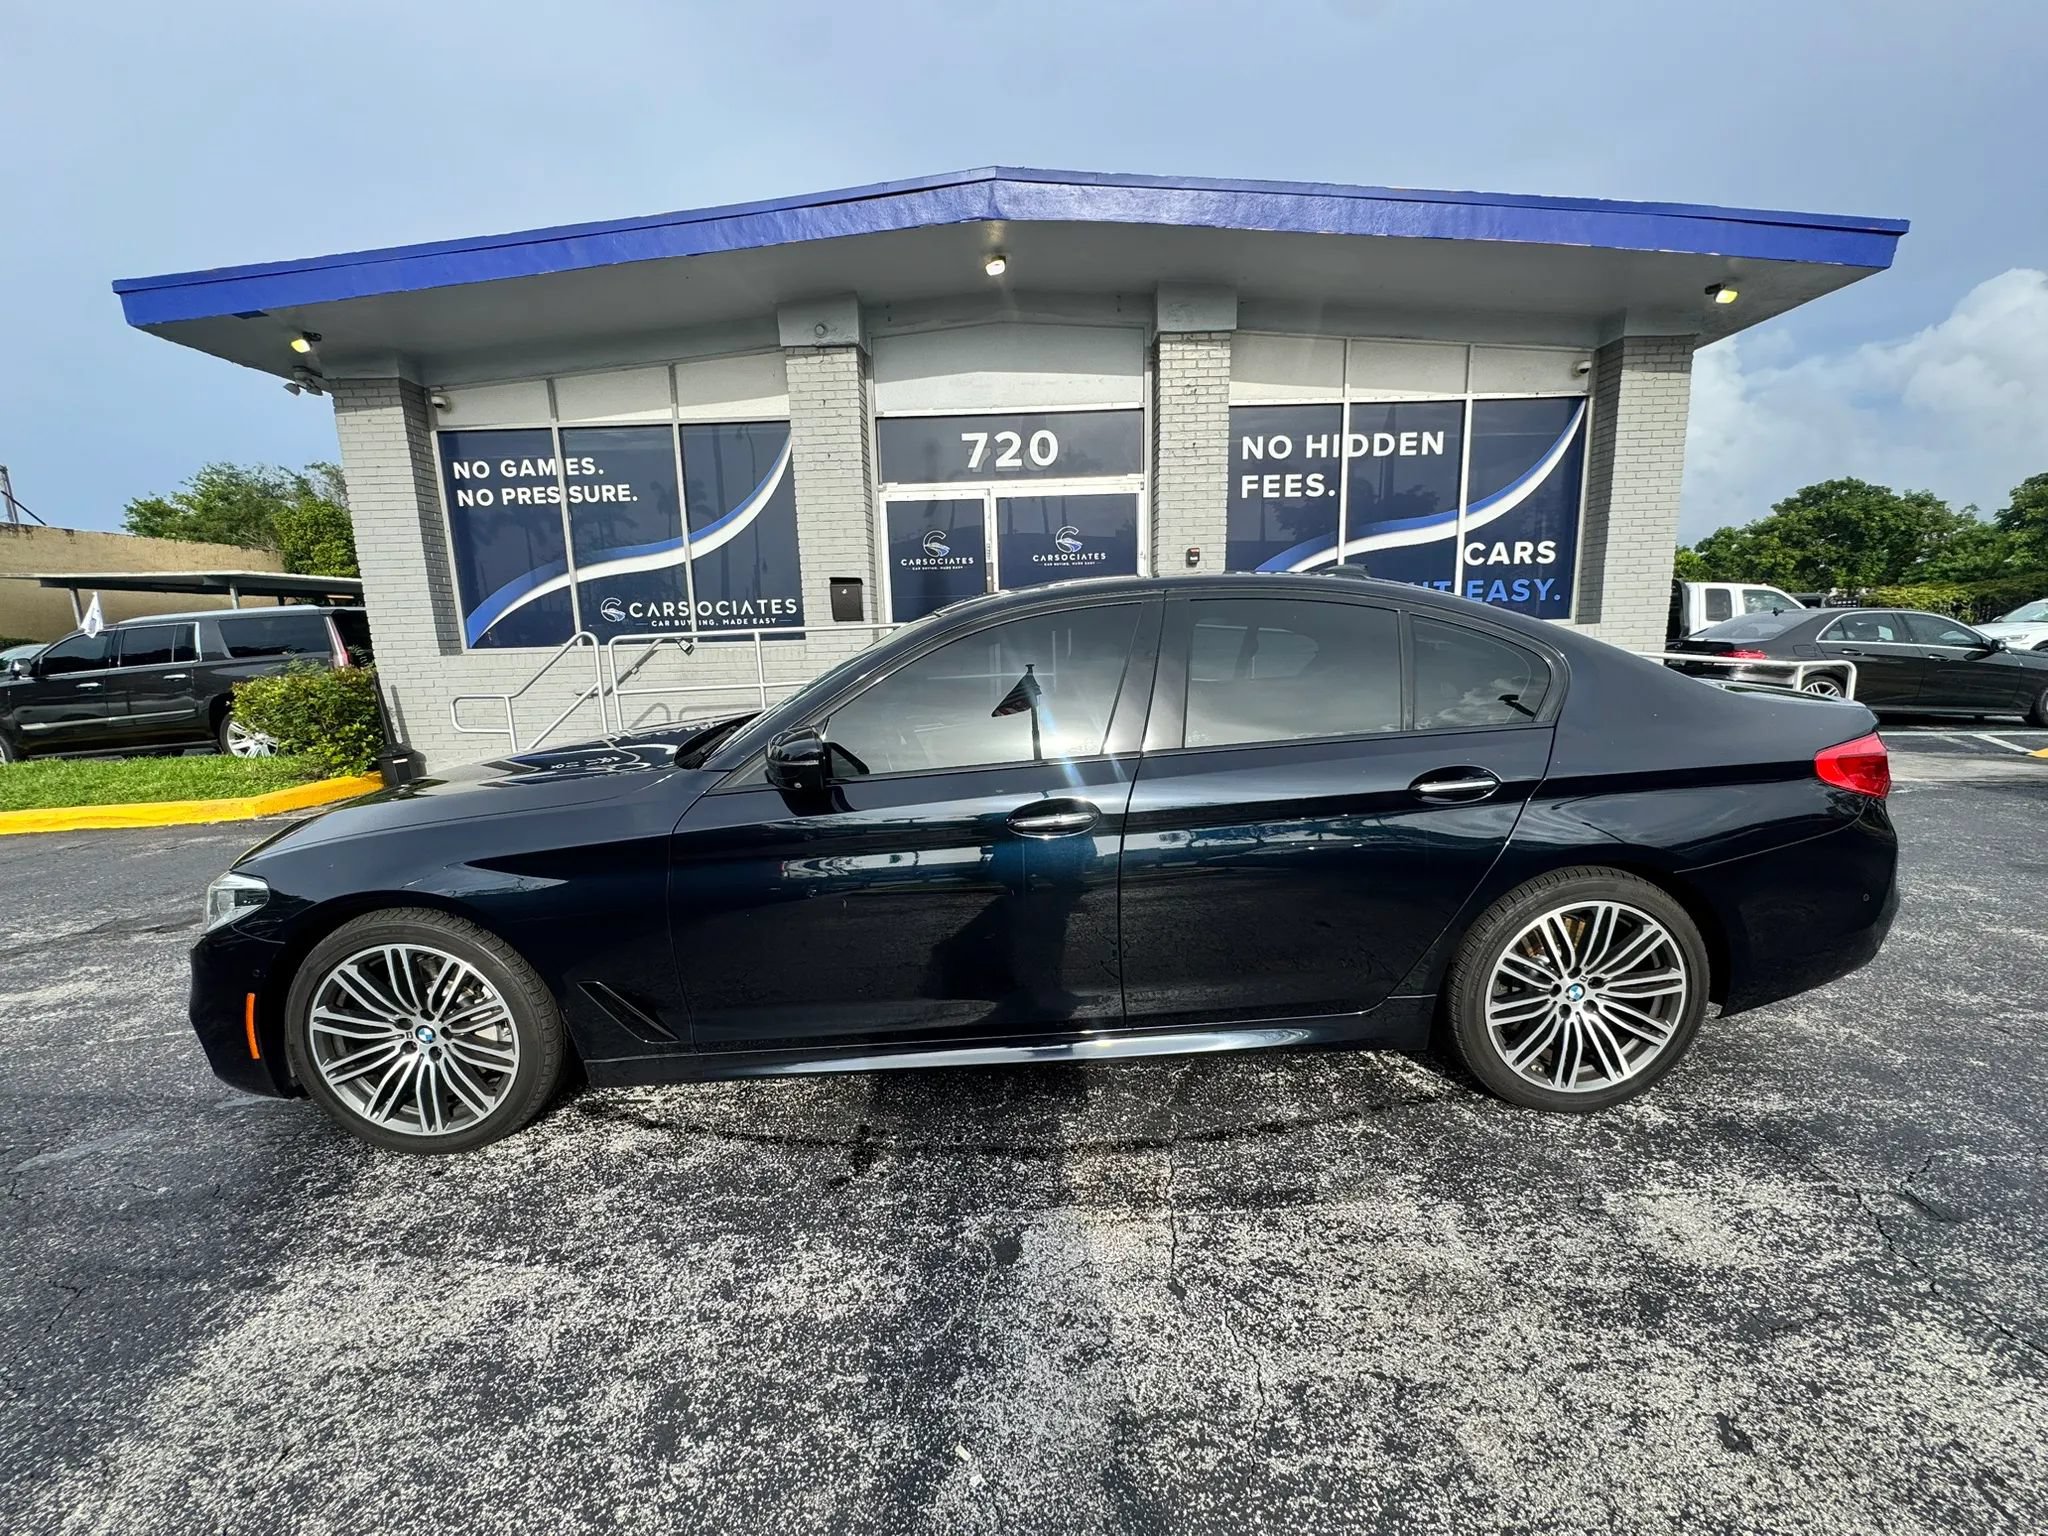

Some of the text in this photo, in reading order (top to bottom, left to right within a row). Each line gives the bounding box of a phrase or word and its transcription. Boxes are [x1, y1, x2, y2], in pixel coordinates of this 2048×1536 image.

[961, 429, 1059, 468] 720
[1242, 431, 1444, 460] NO HIDDEN
[453, 457, 604, 479] NO GAMES.
[457, 484, 638, 507] NO PRESSURE.
[1241, 473, 1336, 499] FEES.
[901, 557, 974, 566] CARSOCIATES
[1033, 553, 1106, 562] CARSOCIATES
[1464, 541, 1556, 566] CARS
[1467, 578, 1561, 602] EASY.
[629, 599, 797, 617] CARSOCIATES
[723, 618, 748, 626] MADE
[753, 617, 777, 625] EASY
